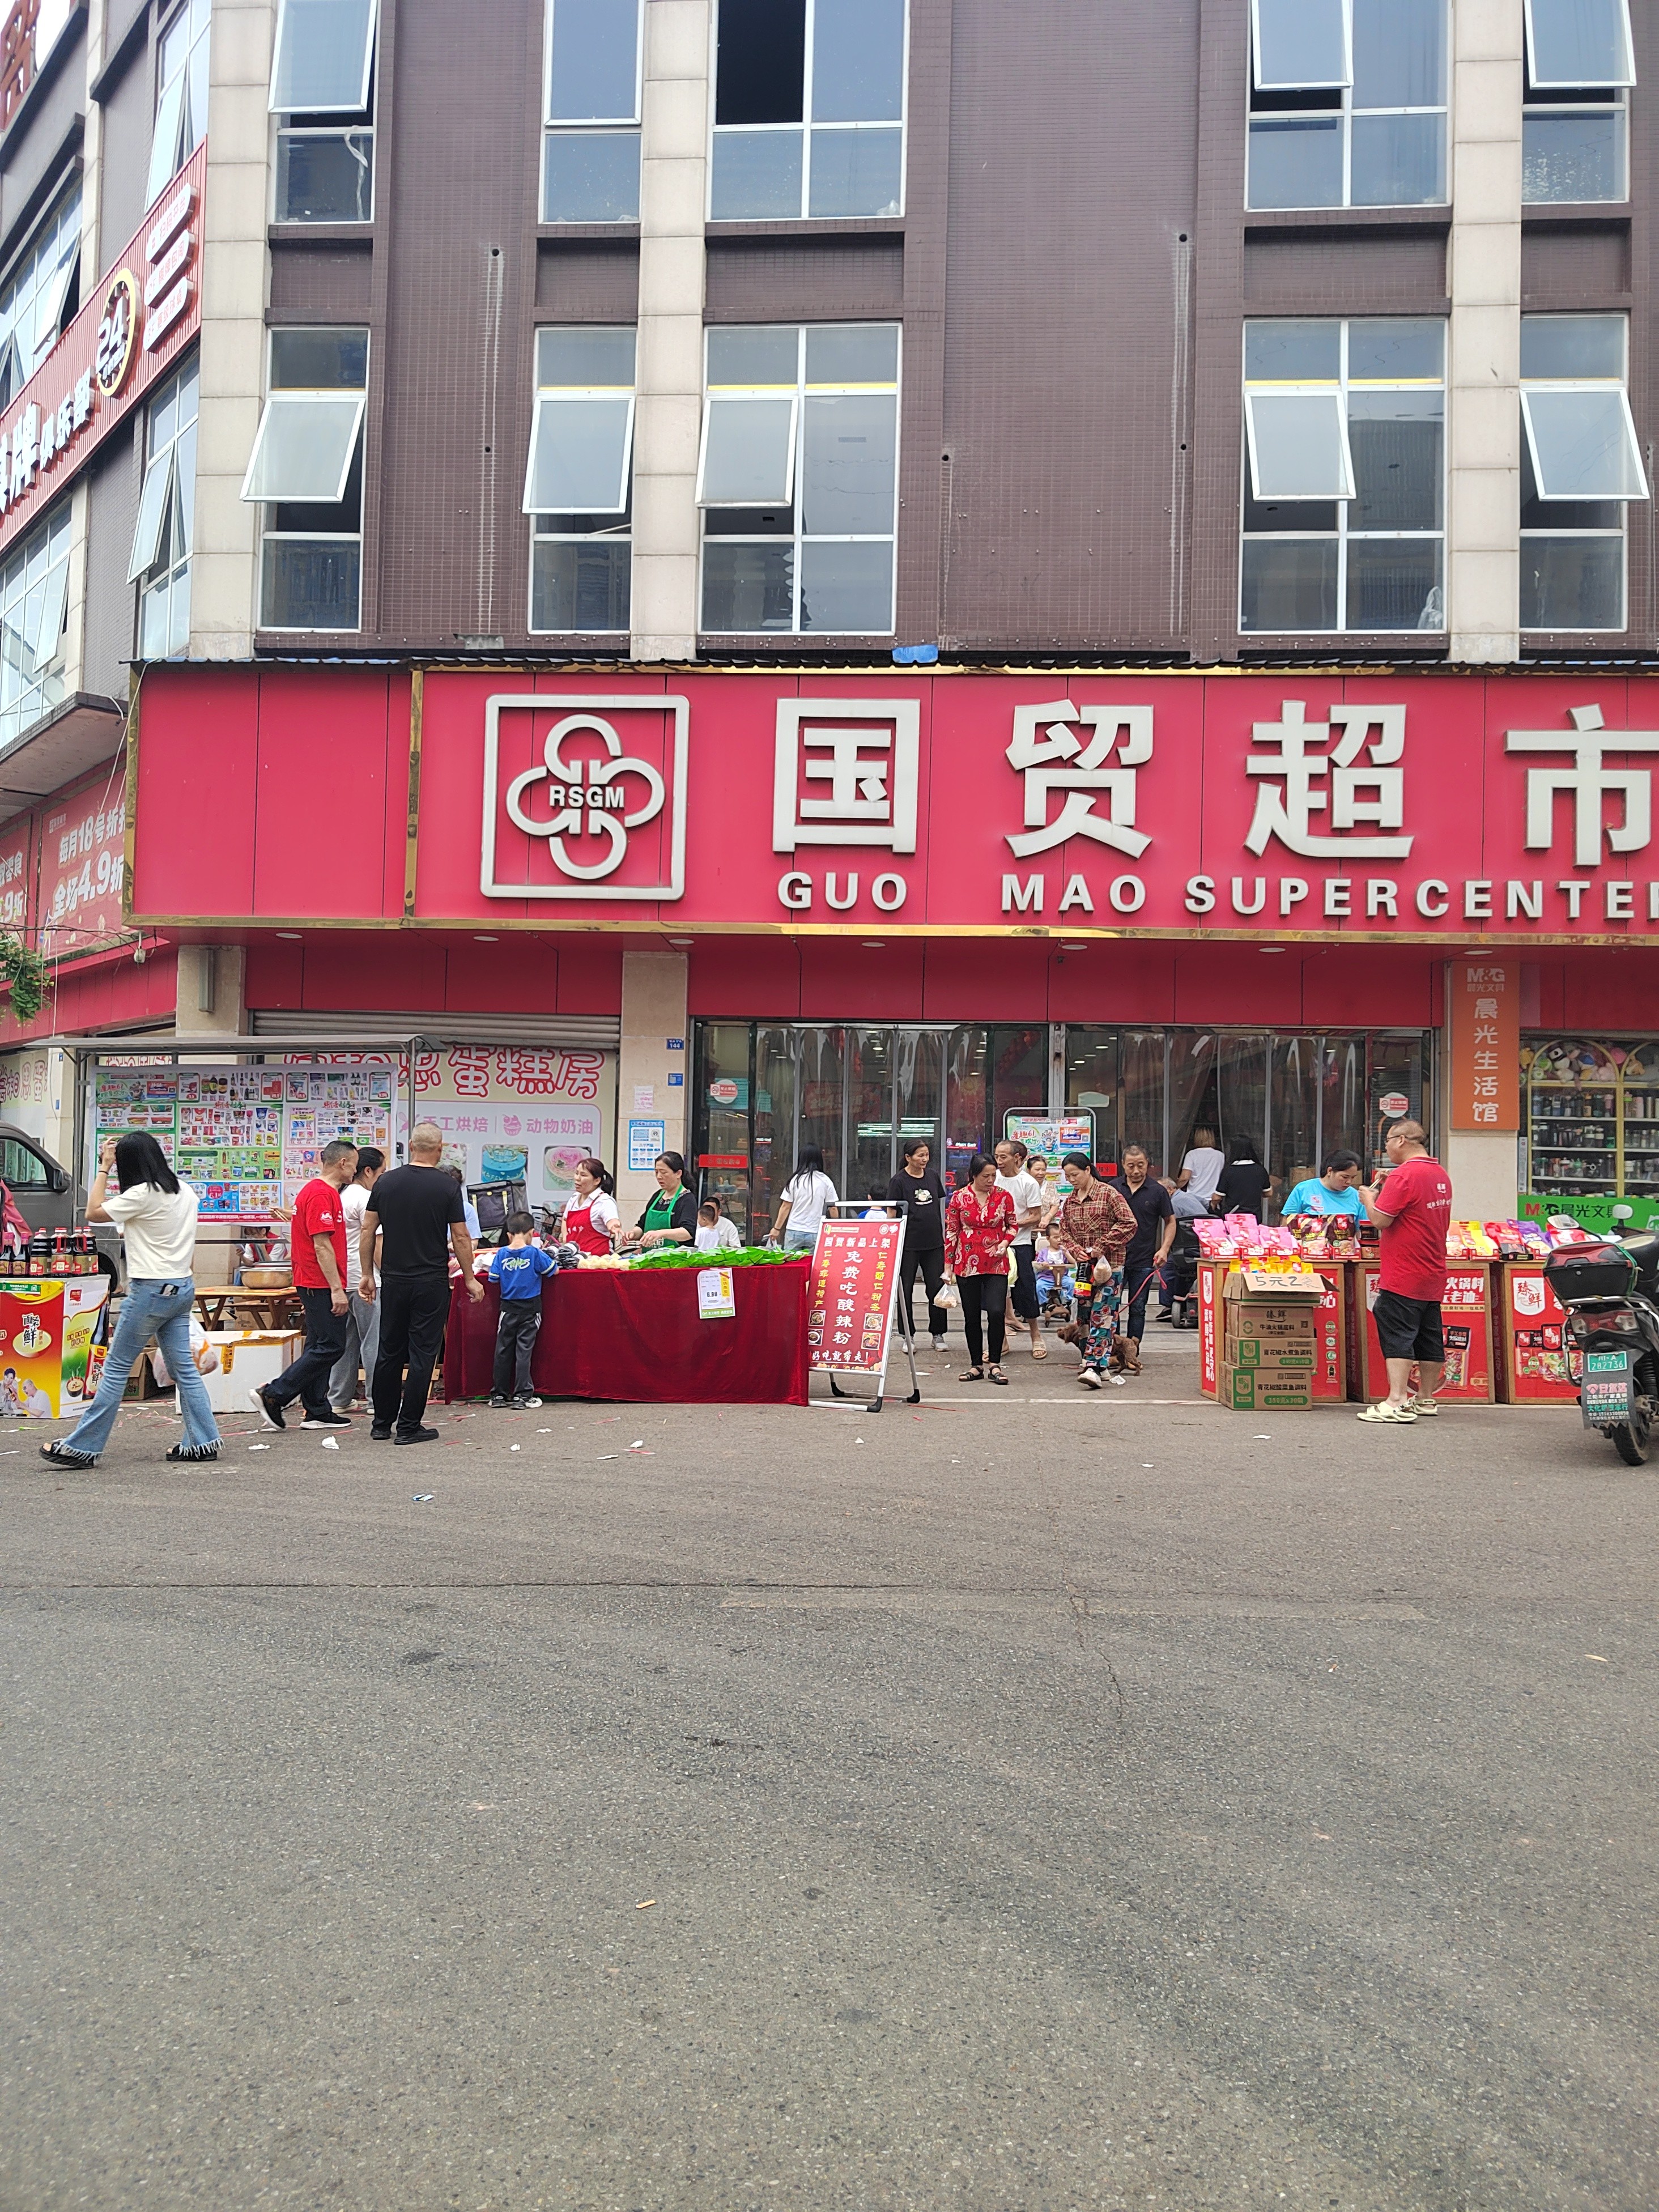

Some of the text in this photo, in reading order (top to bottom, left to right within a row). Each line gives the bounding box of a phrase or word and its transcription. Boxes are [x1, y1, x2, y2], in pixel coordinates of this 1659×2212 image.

[96, 296, 126, 374] 24
[773, 699, 1659, 866] 国贸超市
[548, 784, 624, 809] RSGM
[54, 850, 124, 919] 全场4.9折
[778, 872, 907, 910] GUO
[1001, 874, 1146, 913] MAO
[1466, 968, 1505, 982] M&G
[1466, 984, 1504, 992] 晨光文具
[1472, 998, 1499, 1122] 晨光生活馆
[526, 1118, 594, 1135] 动物奶油
[824, 1236, 891, 1249] 国贸新品上架
[832, 1250, 863, 1345] 免费吃酸辣粉
[1445, 1277, 1484, 1293] 火锅料
[1592, 1360, 1624, 1371] 282736
